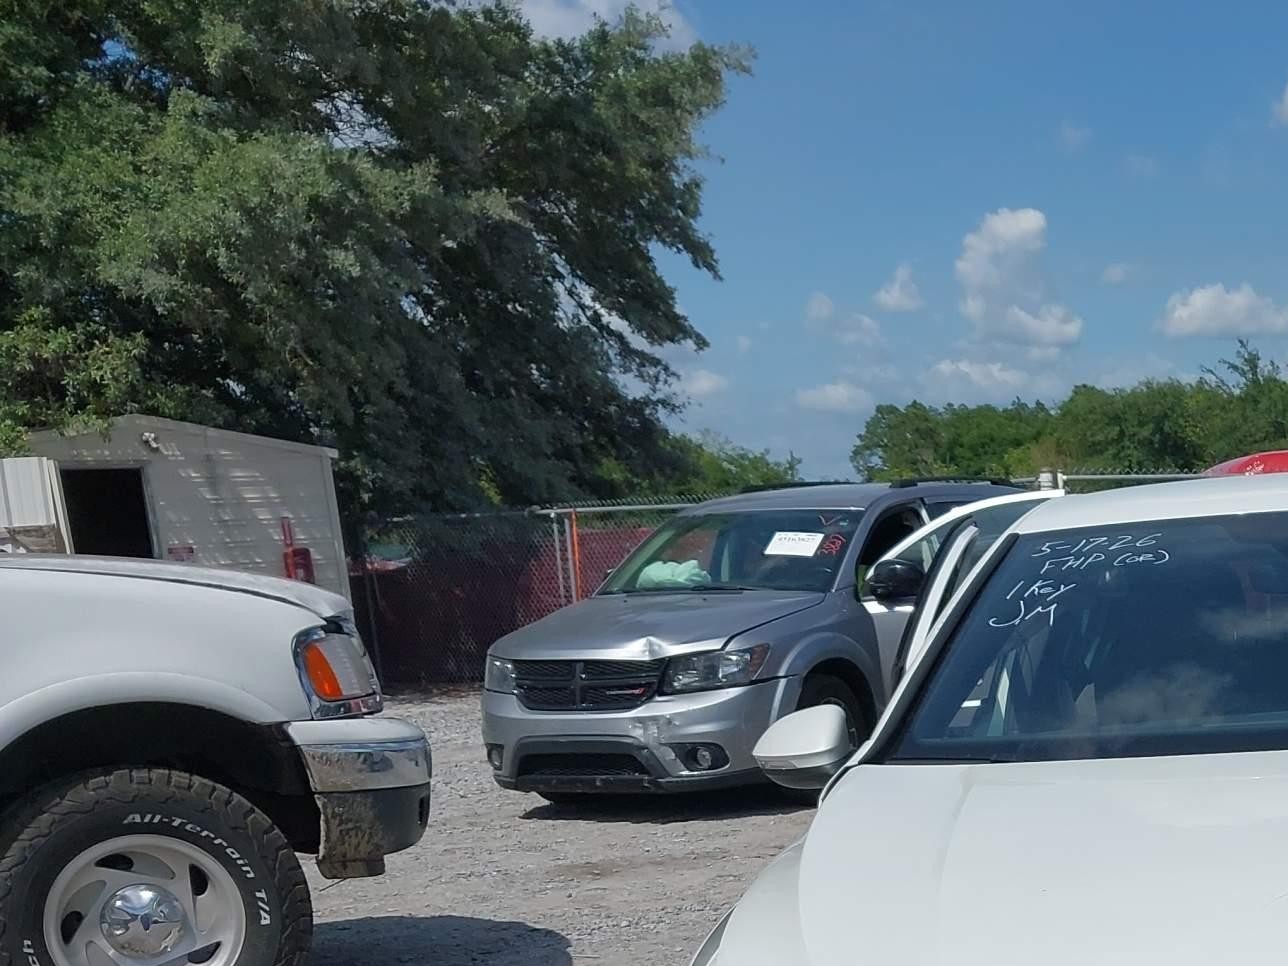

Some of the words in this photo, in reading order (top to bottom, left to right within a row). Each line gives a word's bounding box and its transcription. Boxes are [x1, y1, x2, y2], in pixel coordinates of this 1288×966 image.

[1024, 579, 1077, 601] Key
[122, 813, 256, 879] All-Terrain
[254, 888, 271, 926] T/A
